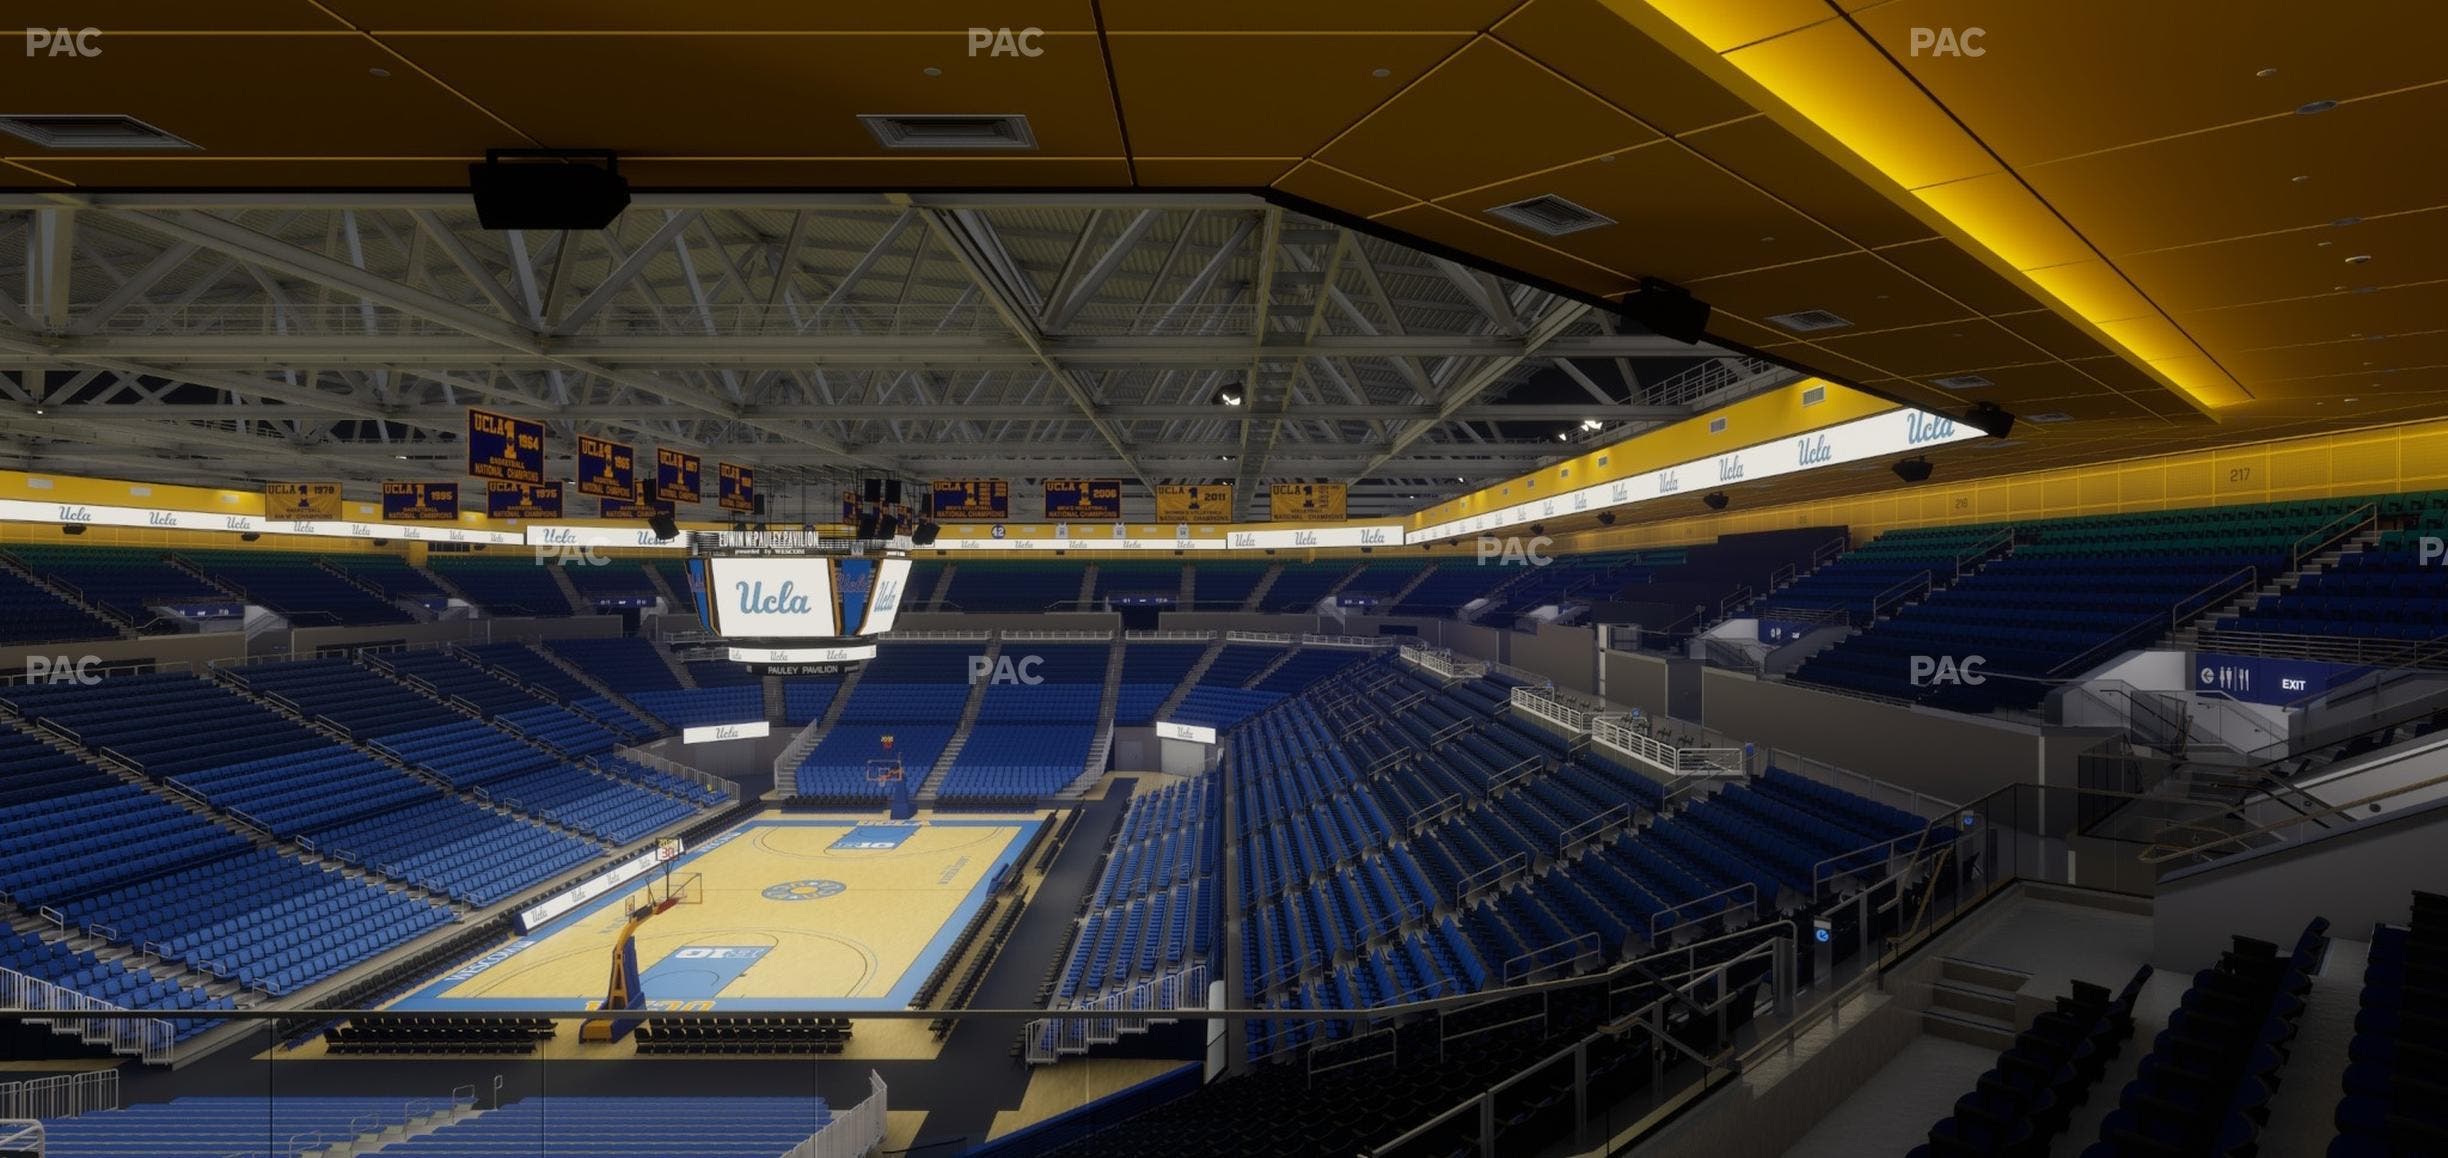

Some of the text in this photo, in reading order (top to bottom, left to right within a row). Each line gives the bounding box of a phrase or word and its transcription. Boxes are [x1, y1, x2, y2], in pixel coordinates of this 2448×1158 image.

[474, 413, 505, 436] UCLA
[1907, 411, 1955, 445] Ucla
[581, 439, 604, 458] UCLA
[1798, 435, 1832, 466] Ucla
[1719, 455, 1744, 482] Ucla
[2230, 467, 2250, 482] 217
[268, 486, 295, 494] UCLA
[385, 485, 412, 494] UCLA
[489, 482, 518, 492] UCLA
[934, 482, 961, 491] UCLA
[1046, 482, 1075, 492] UCLA
[1273, 485, 1301, 495] UCLA
[1659, 473, 1680, 493] Ucla
[1158, 487, 1185, 495] UCLA
[1204, 493, 1226, 501] 2011
[1612, 482, 1628, 502] Ucla
[59, 506, 91, 522] Ucla
[149, 512, 177, 526] Ucla
[226, 517, 251, 530] Ucla
[294, 522, 314, 533] Ucla
[543, 528, 577, 544] Ucla
[718, 531, 744, 548] EDWIN
[753, 531, 783, 548] PAULEY
[783, 531, 819, 548] PAVILION
[992, 528, 1004, 537] 42
[1295, 531, 1317, 546] Ucla
[1361, 529, 1384, 544] Ucla
[1235, 534, 1256, 547] Ucla
[735, 580, 813, 615] Ucla
[874, 580, 897, 613] Ucla
[768, 666, 798, 675] PAULEY
[802, 665, 838, 674] PAVILION
[2282, 679, 2306, 691] EXIT
[716, 727, 738, 739] Ucla
[531, 906, 548, 922] Ucla
